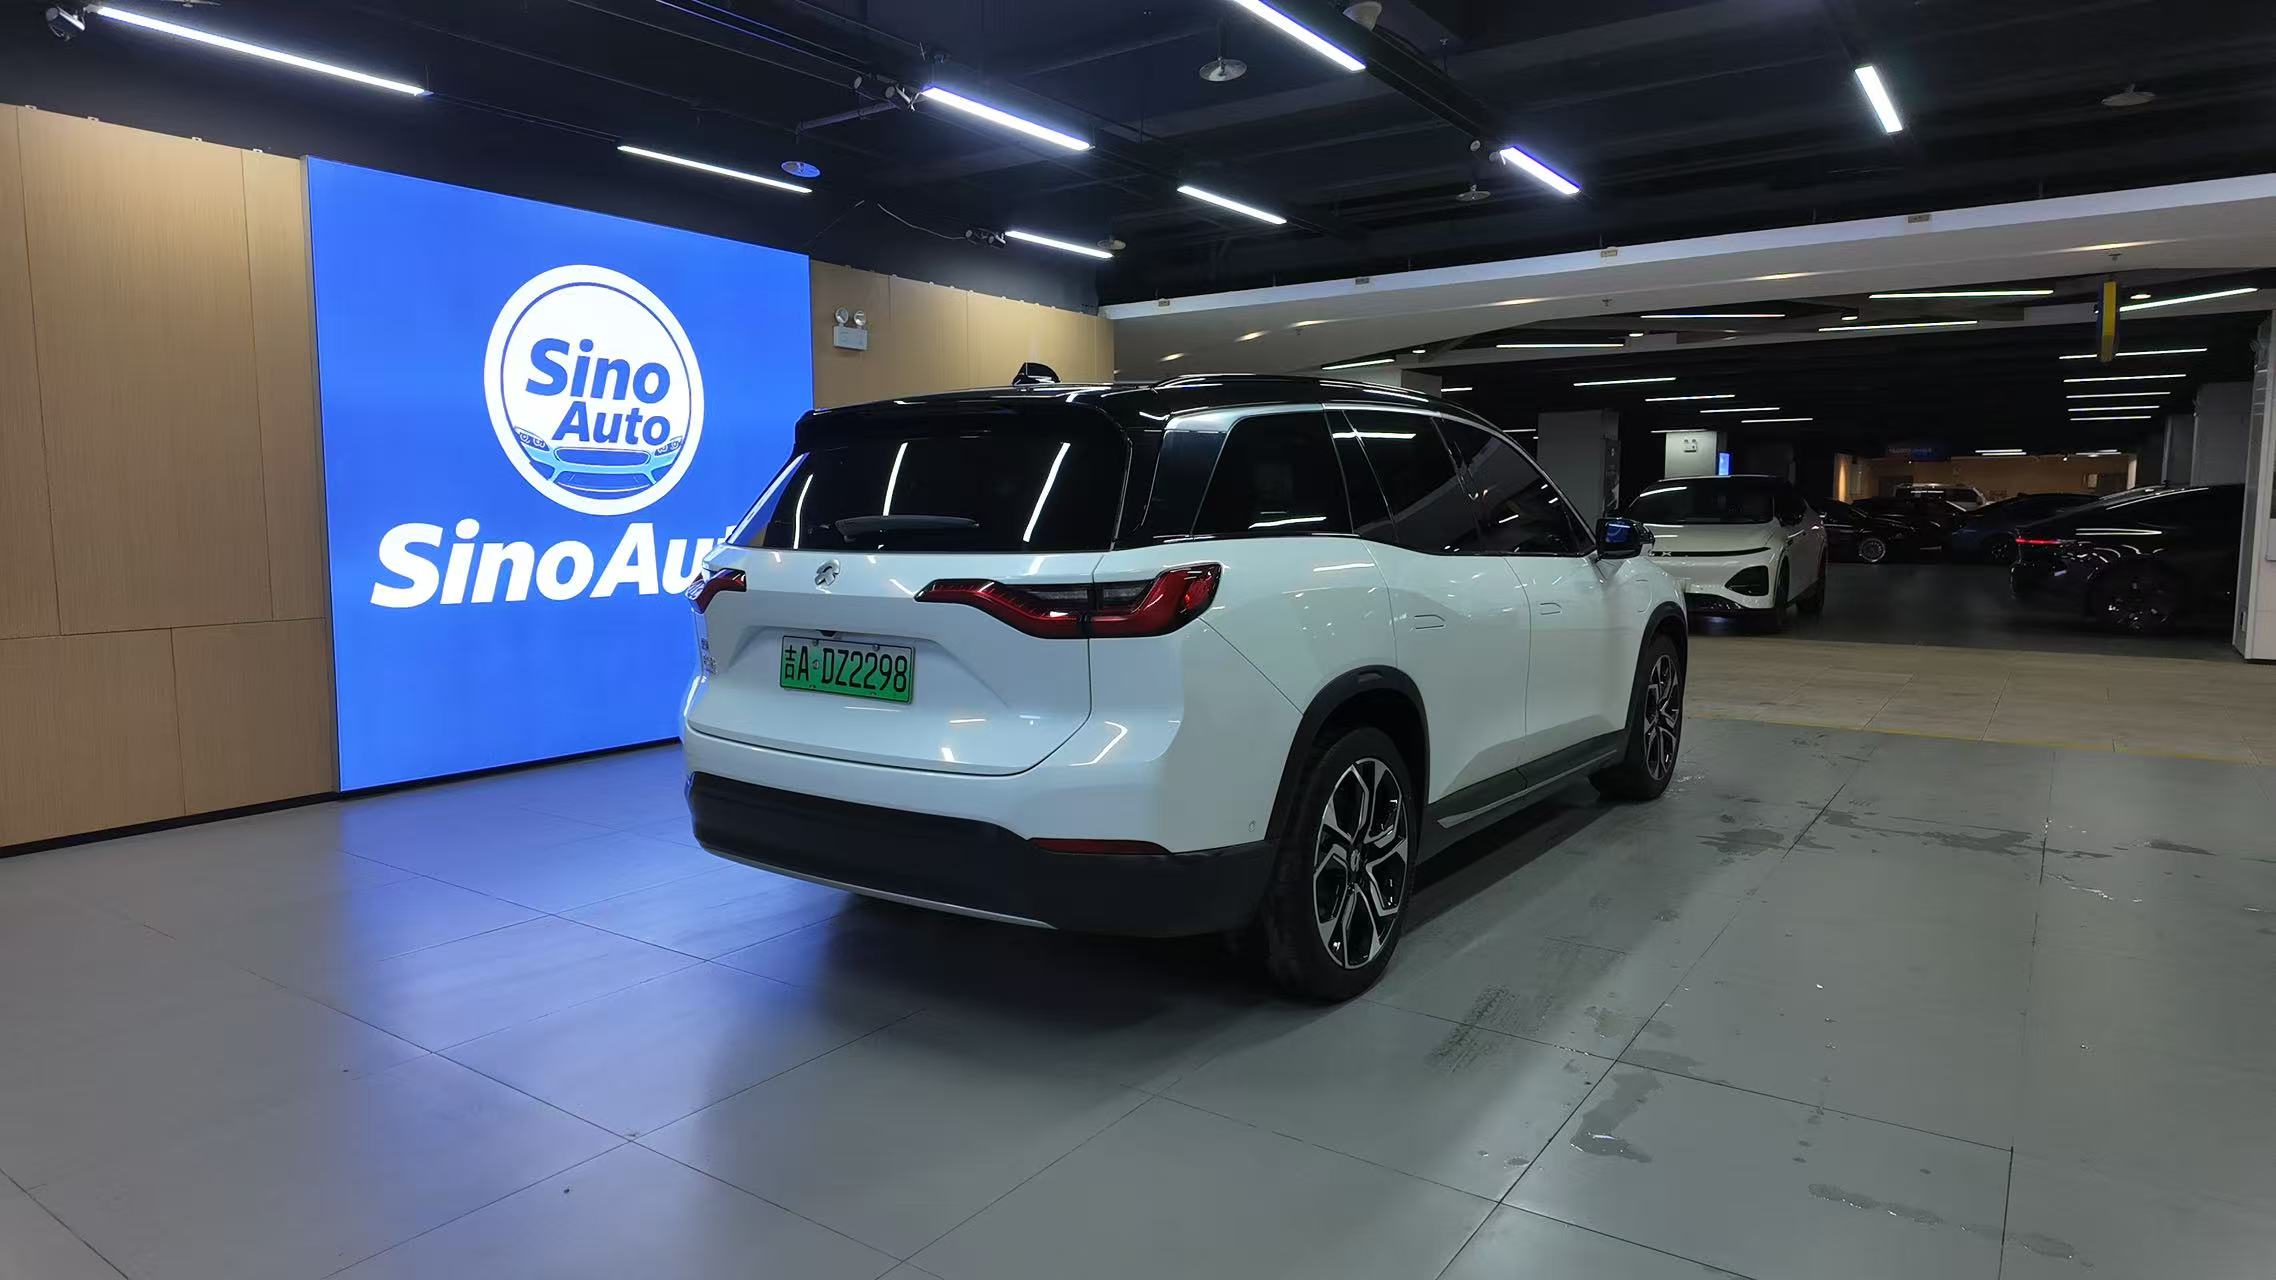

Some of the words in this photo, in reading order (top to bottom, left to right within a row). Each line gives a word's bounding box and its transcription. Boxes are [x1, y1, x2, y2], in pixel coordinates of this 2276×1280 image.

[526, 338, 670, 403] Sino
[552, 401, 670, 446] Auto
[370, 518, 737, 608] SinoAu
